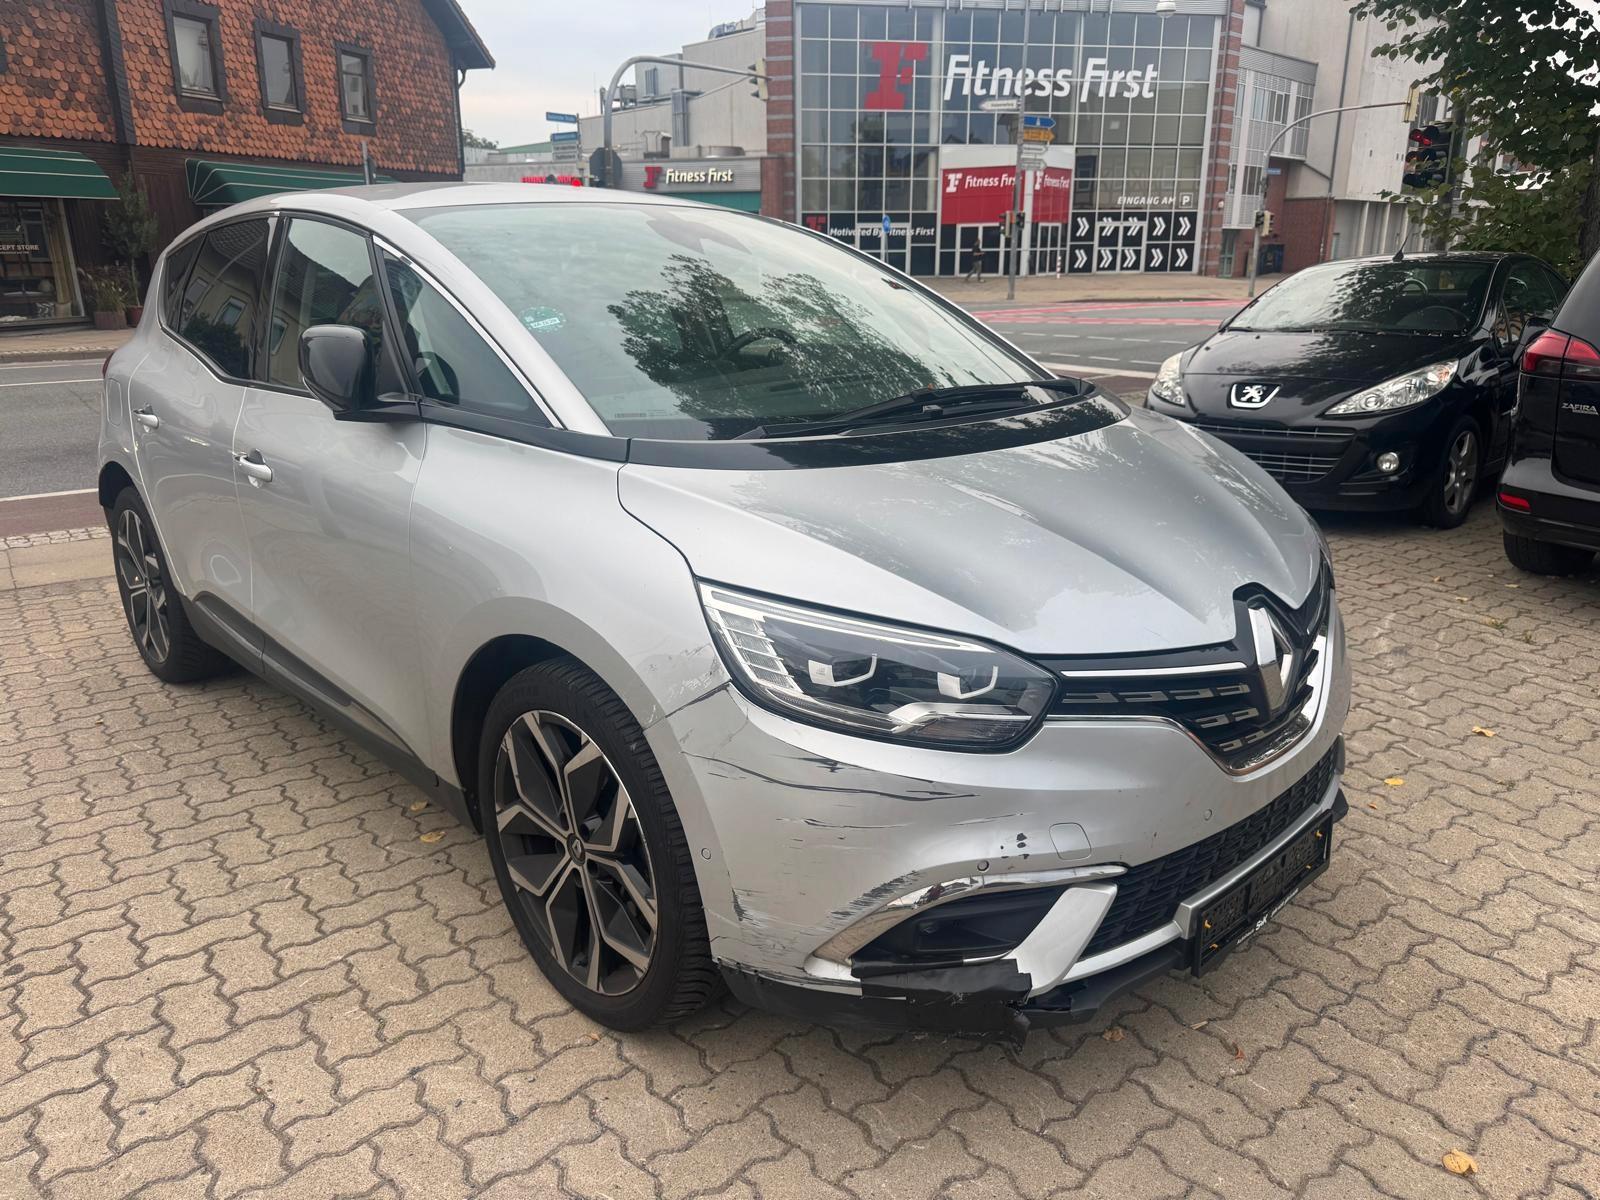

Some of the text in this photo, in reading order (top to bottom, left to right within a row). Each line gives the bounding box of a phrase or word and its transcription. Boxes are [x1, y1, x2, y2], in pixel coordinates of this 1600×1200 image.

[944, 54, 1158, 103] Fitness First
[1117, 195, 1159, 205] EINGANG
[1161, 196, 1177, 205] AM
[830, 227, 935, 238] Motivated By itness First
[1560, 402, 1597, 412] ZAFIRA
